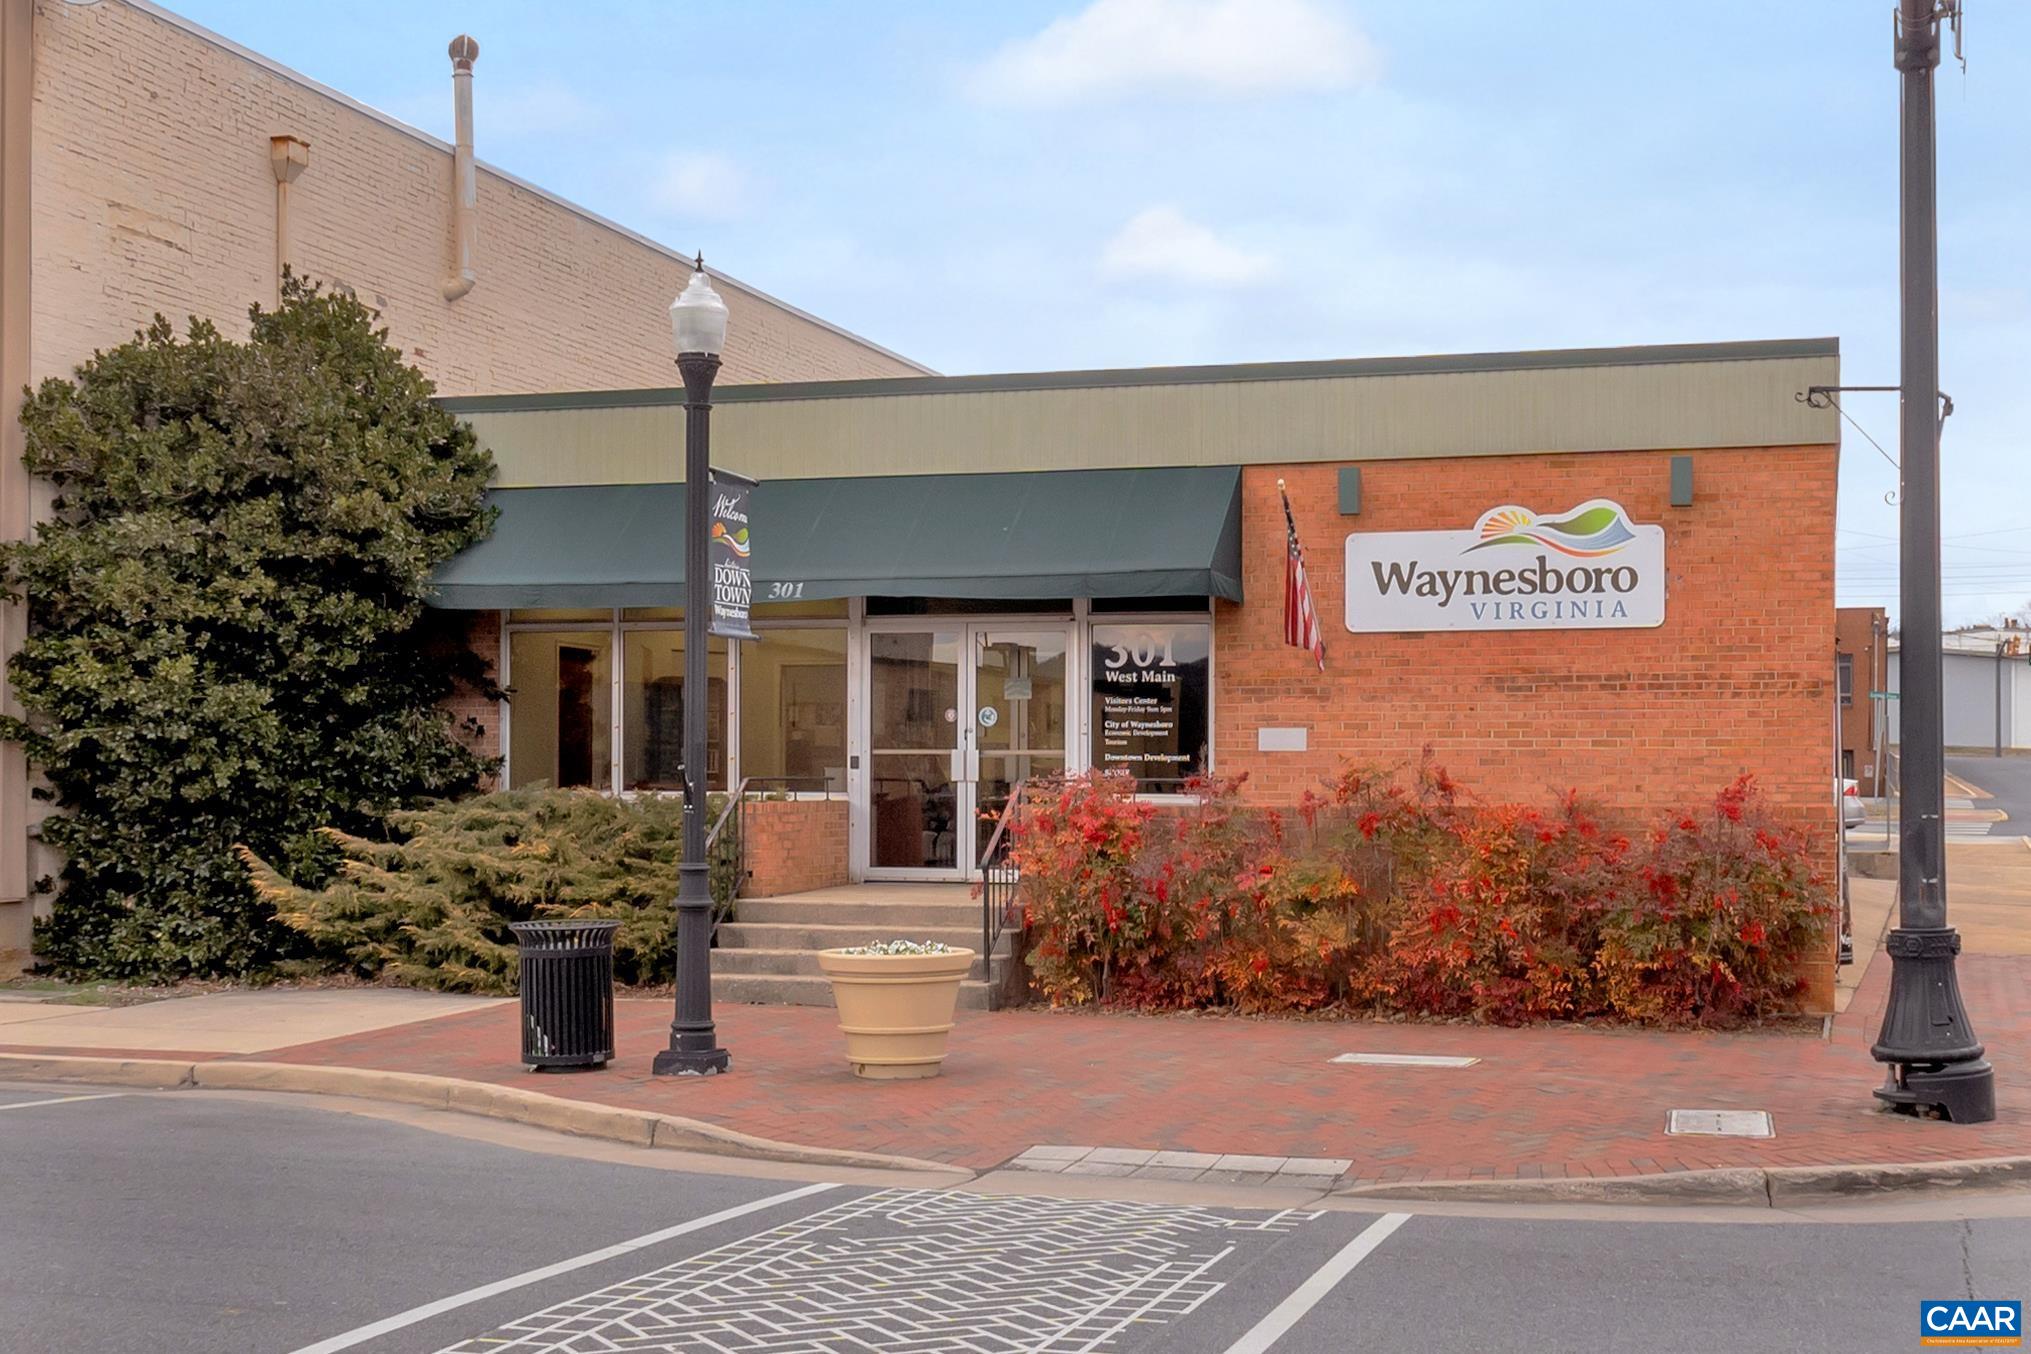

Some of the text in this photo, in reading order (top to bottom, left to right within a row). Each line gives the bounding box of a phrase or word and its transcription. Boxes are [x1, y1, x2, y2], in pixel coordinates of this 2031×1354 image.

[712, 493, 748, 524] Welcom
[714, 567, 752, 588] DOWN
[1371, 555, 1639, 608] Waynesboro
[714, 583, 752, 604] TOWN
[768, 582, 804, 599] 301
[1470, 600, 1628, 620] VIRGINIA
[1104, 632, 1177, 669] 301
[1105, 670, 1176, 683] West Main
[1104, 697, 1158, 705] Visitors Center
[1104, 720, 1174, 729] City of Waynesboro
[1104, 753, 1190, 763] Downtown Development
